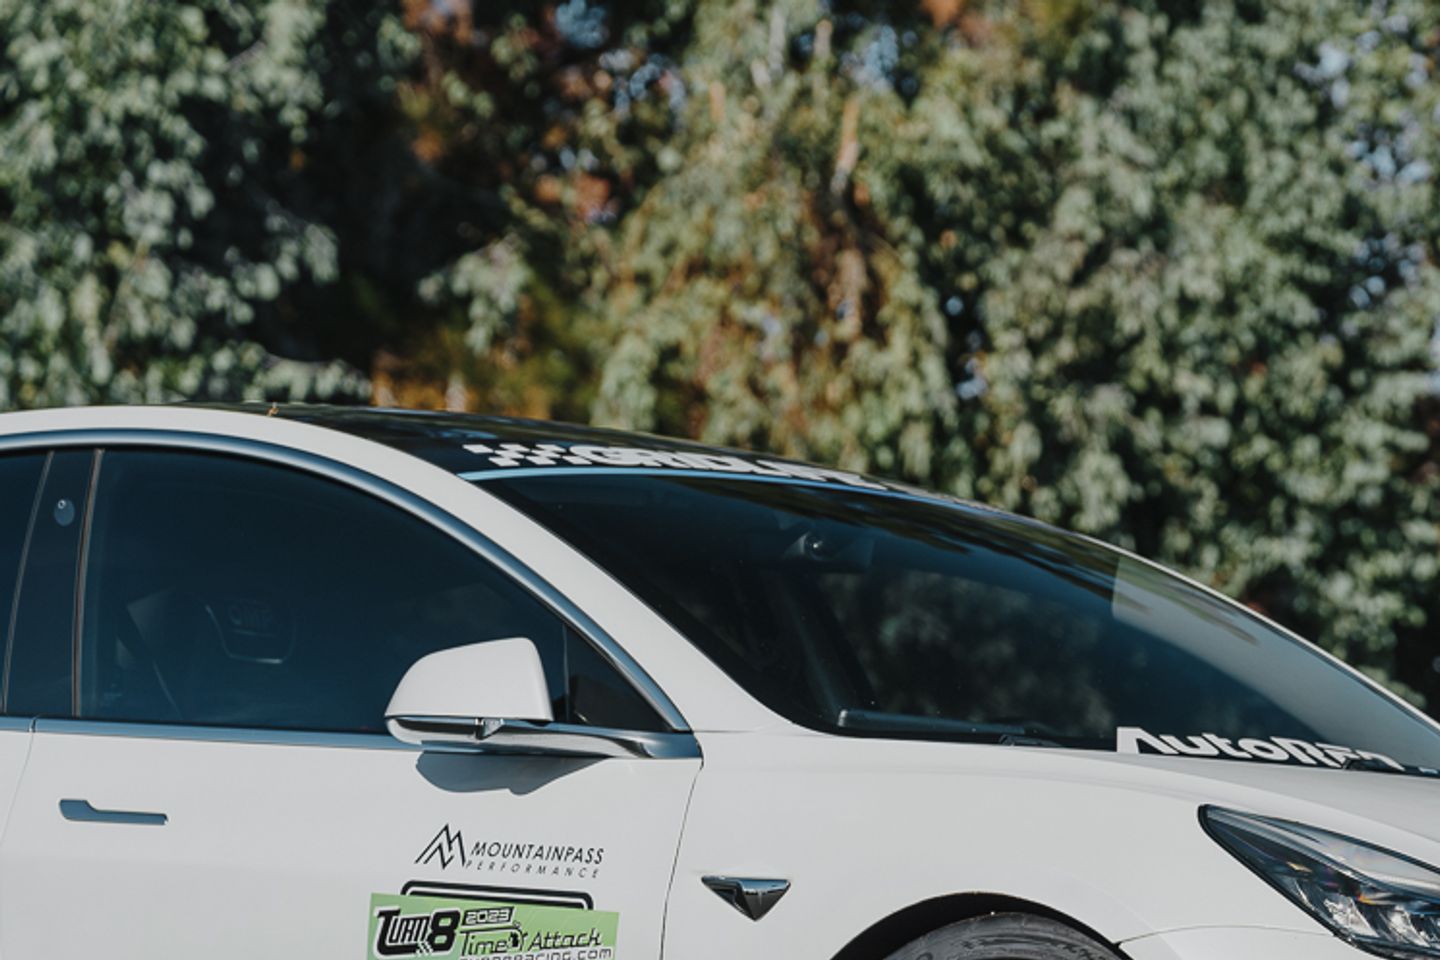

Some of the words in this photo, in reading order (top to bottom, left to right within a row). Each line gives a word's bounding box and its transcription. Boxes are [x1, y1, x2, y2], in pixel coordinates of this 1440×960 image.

[471, 841, 605, 865] MOUNTAINPASS
[466, 860, 600, 879] PERFORMANCE
[465, 907, 512, 925] 2023
[460, 929, 508, 957] Time
[528, 928, 602, 952] Attack
